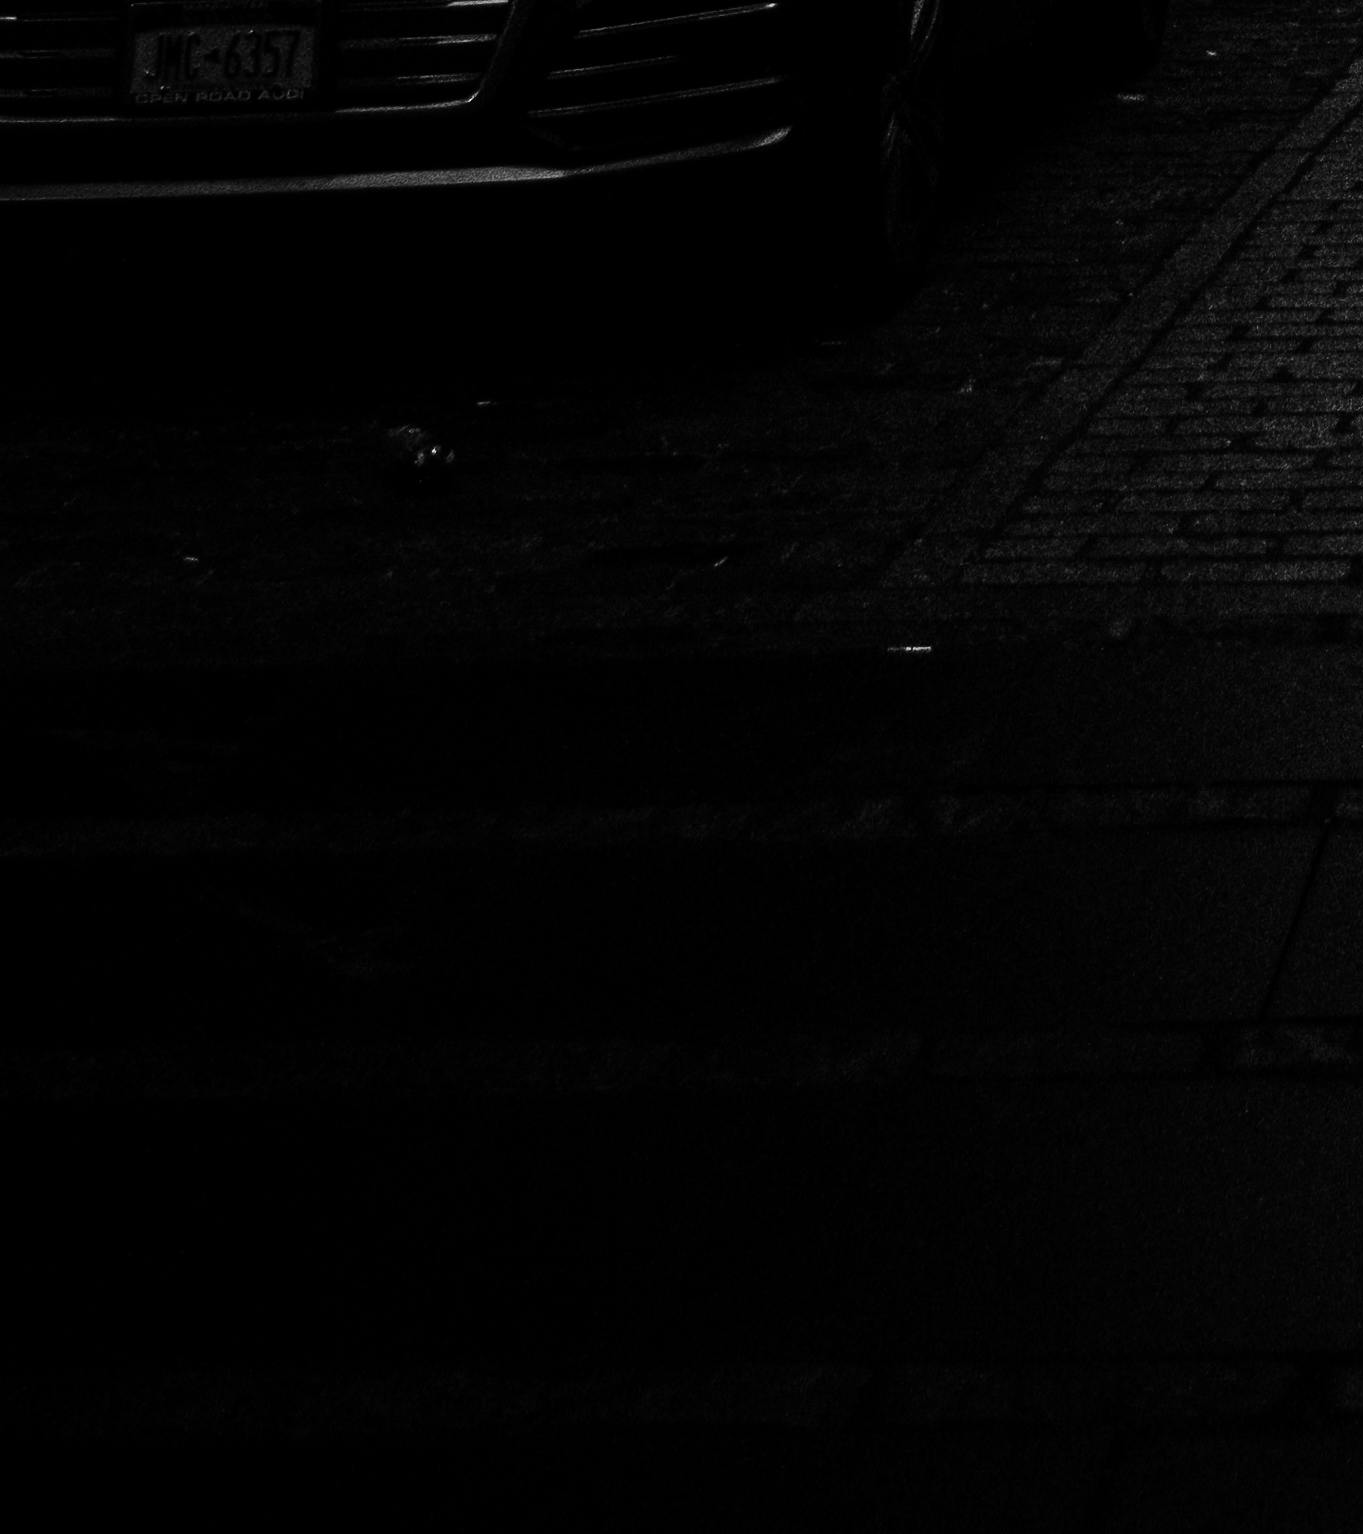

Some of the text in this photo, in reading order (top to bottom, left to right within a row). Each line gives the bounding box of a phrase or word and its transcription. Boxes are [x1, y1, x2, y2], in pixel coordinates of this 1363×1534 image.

[134, 88, 305, 104] OPEN ROAD AUDI
